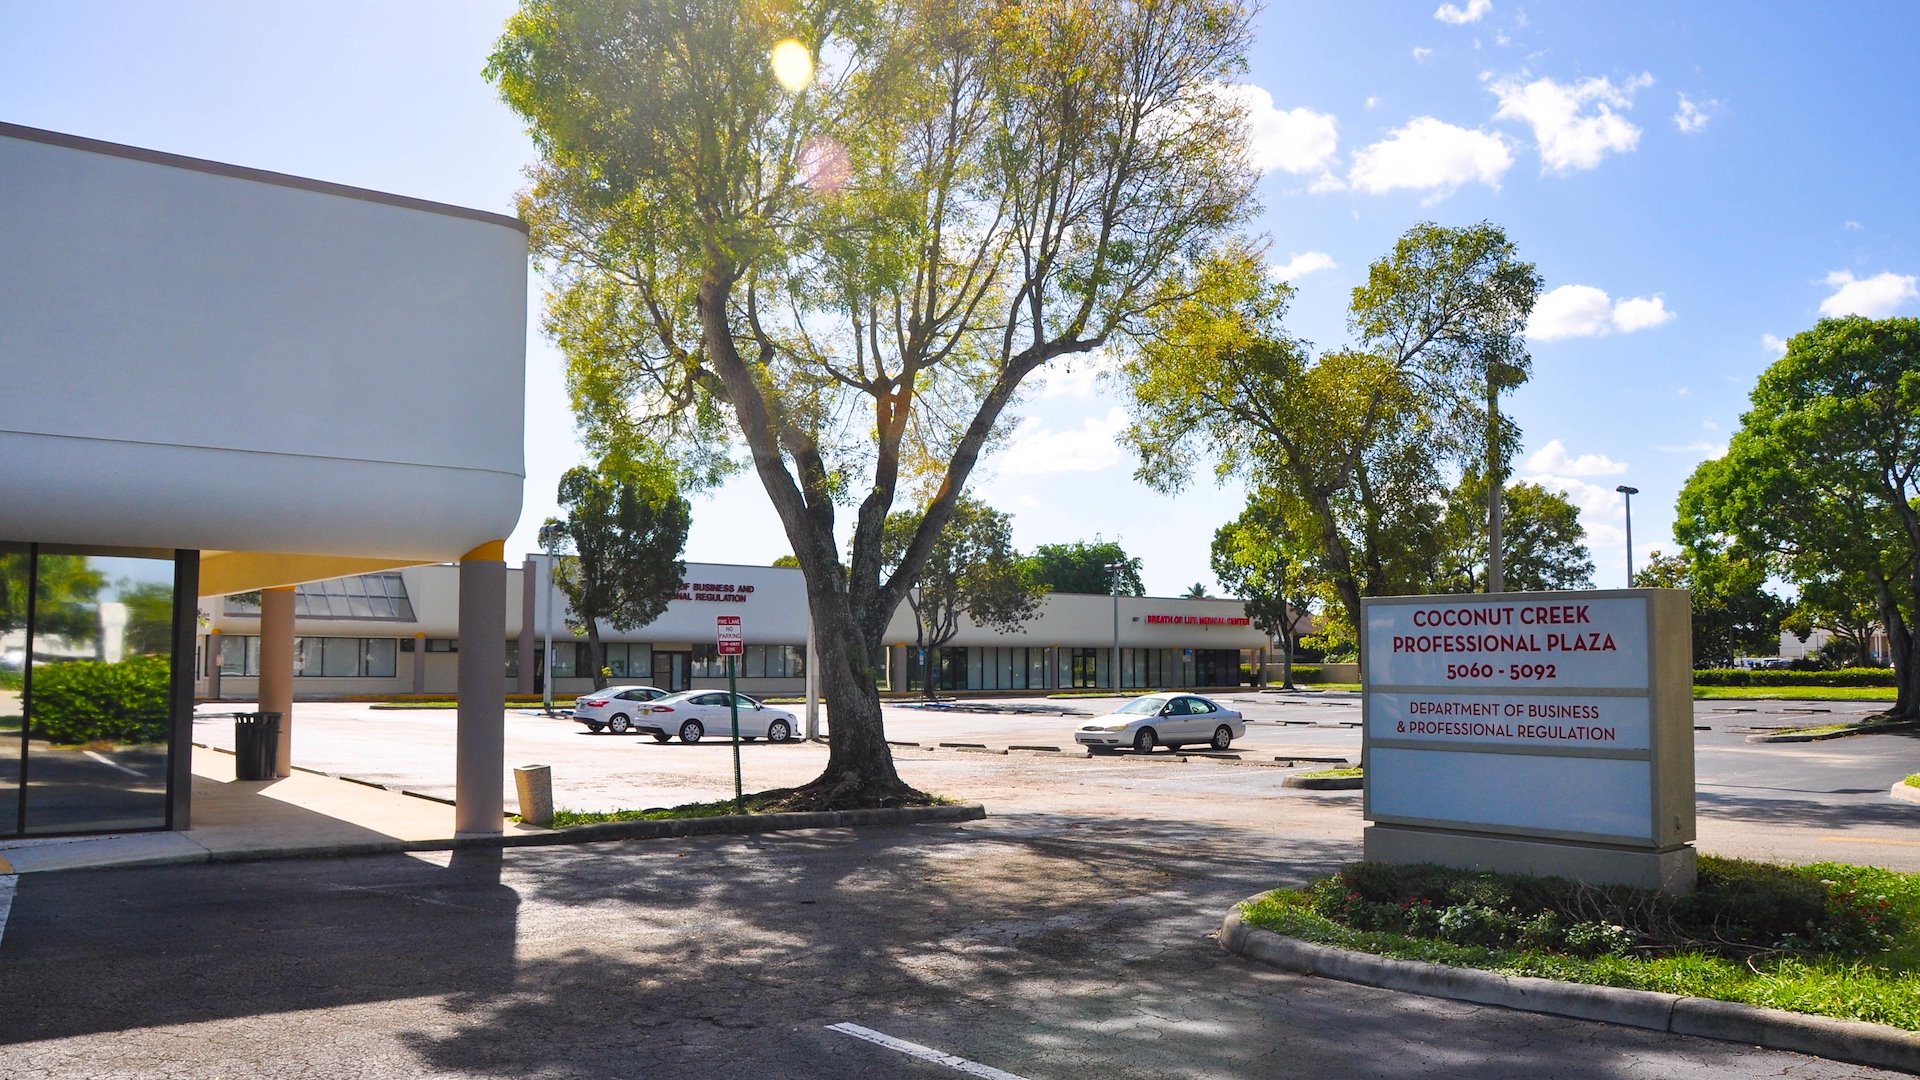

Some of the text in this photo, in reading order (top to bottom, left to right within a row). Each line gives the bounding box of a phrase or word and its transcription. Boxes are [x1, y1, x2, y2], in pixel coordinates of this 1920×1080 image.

[693, 583, 735, 593] BUSINESS
[737, 585, 755, 593] AND
[695, 593, 746, 602] REGULATION
[1147, 615, 1173, 625] BREATH
[1199, 616, 1225, 625] MEDICAL
[1226, 617, 1250, 626] CENTER
[1413, 605, 1590, 627] COCONUT CREEK
[1393, 633, 1617, 653] PROFESSIONAL PLAZA
[1446, 662, 1494, 680] 5060
[1509, 664, 1557, 681] 5092
[1410, 701, 1599, 719] DEPARTMENT OF BUSINESS
[1396, 721, 1615, 741] & PROFESSIONAL REGULATION
